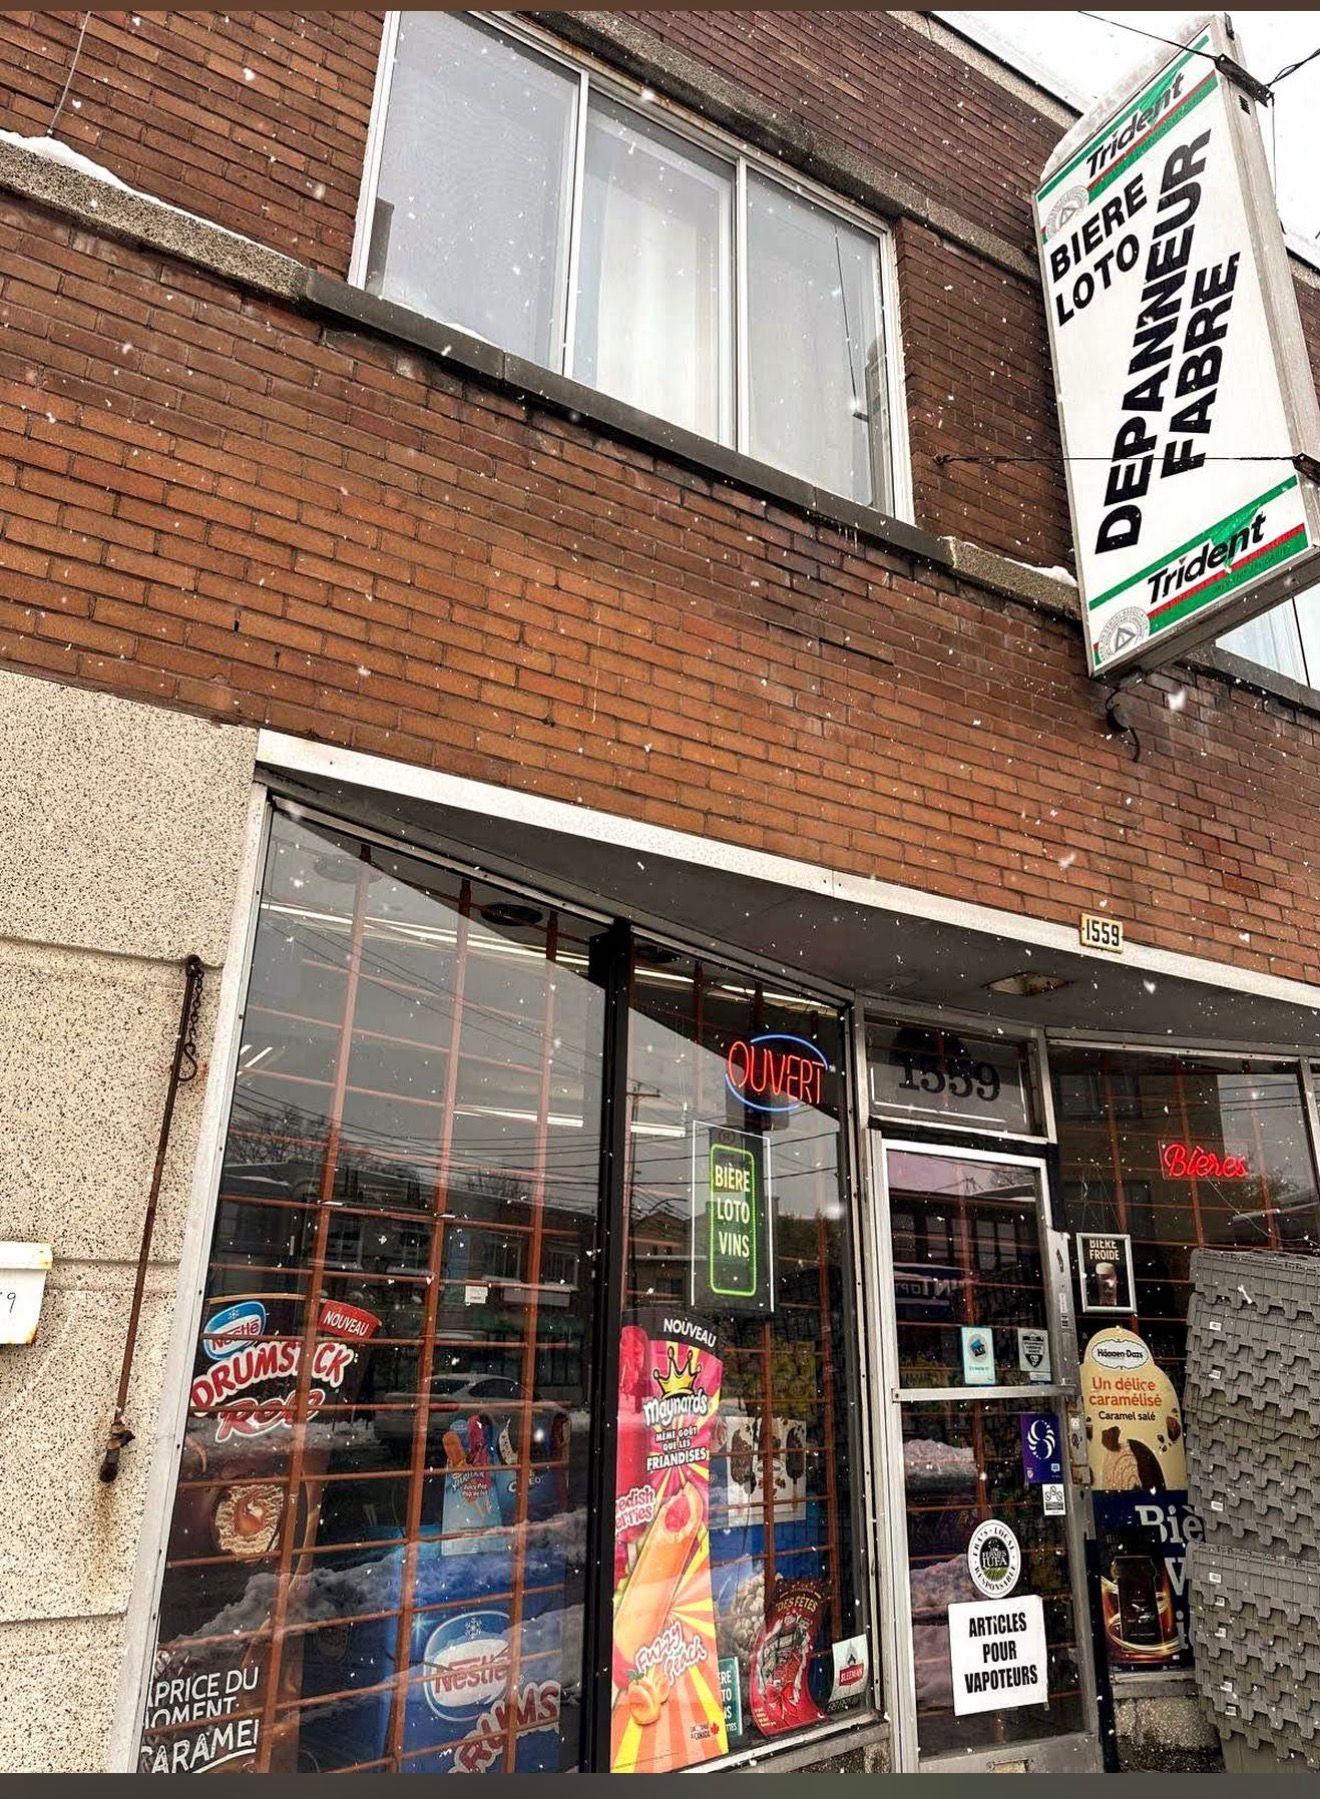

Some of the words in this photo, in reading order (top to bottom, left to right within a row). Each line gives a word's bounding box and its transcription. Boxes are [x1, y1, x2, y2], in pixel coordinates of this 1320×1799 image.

[1086, 72, 1184, 178] Trident
[1050, 173, 1147, 283] BIERE
[1055, 234, 1140, 327] LOTO
[1095, 129, 1211, 554] DEPANNEUR
[1161, 252, 1240, 478] FABRE
[1148, 512, 1265, 604] Trident
[1086, 918, 1119, 947] 1559
[728, 1040, 825, 1105] OUVERT
[898, 1054, 1001, 1102] 1559
[1164, 1143, 1248, 1177] Bières
[714, 1163, 750, 1193] BIÈRE
[717, 1198, 750, 1224] LOTO
[718, 1231, 750, 1258] VINS
[1089, 1249, 1120, 1260] FROIDE
[324, 1311, 369, 1336] NOUVEAU
[663, 1318, 717, 1348] NOUVEAU
[191, 1341, 351, 1408] DRUMSCK
[1092, 1376, 1111, 1390] Un
[1115, 1377, 1156, 1391] délice
[1089, 1393, 1162, 1406] caramélisé
[1098, 1410, 1136, 1420] Caramel
[1138, 1411, 1156, 1420] salé
[646, 1447, 707, 1472] FRIANDISES
[616, 1487, 654, 1511] edish
[616, 1505, 652, 1530] erries
[1135, 1505, 1204, 1543] Biè
[969, 1612, 1027, 1638] ARTICLES
[982, 1640, 1017, 1664] POUR
[225, 1666, 259, 1694] DU
[965, 1664, 1038, 1694] VAPOTEURS
